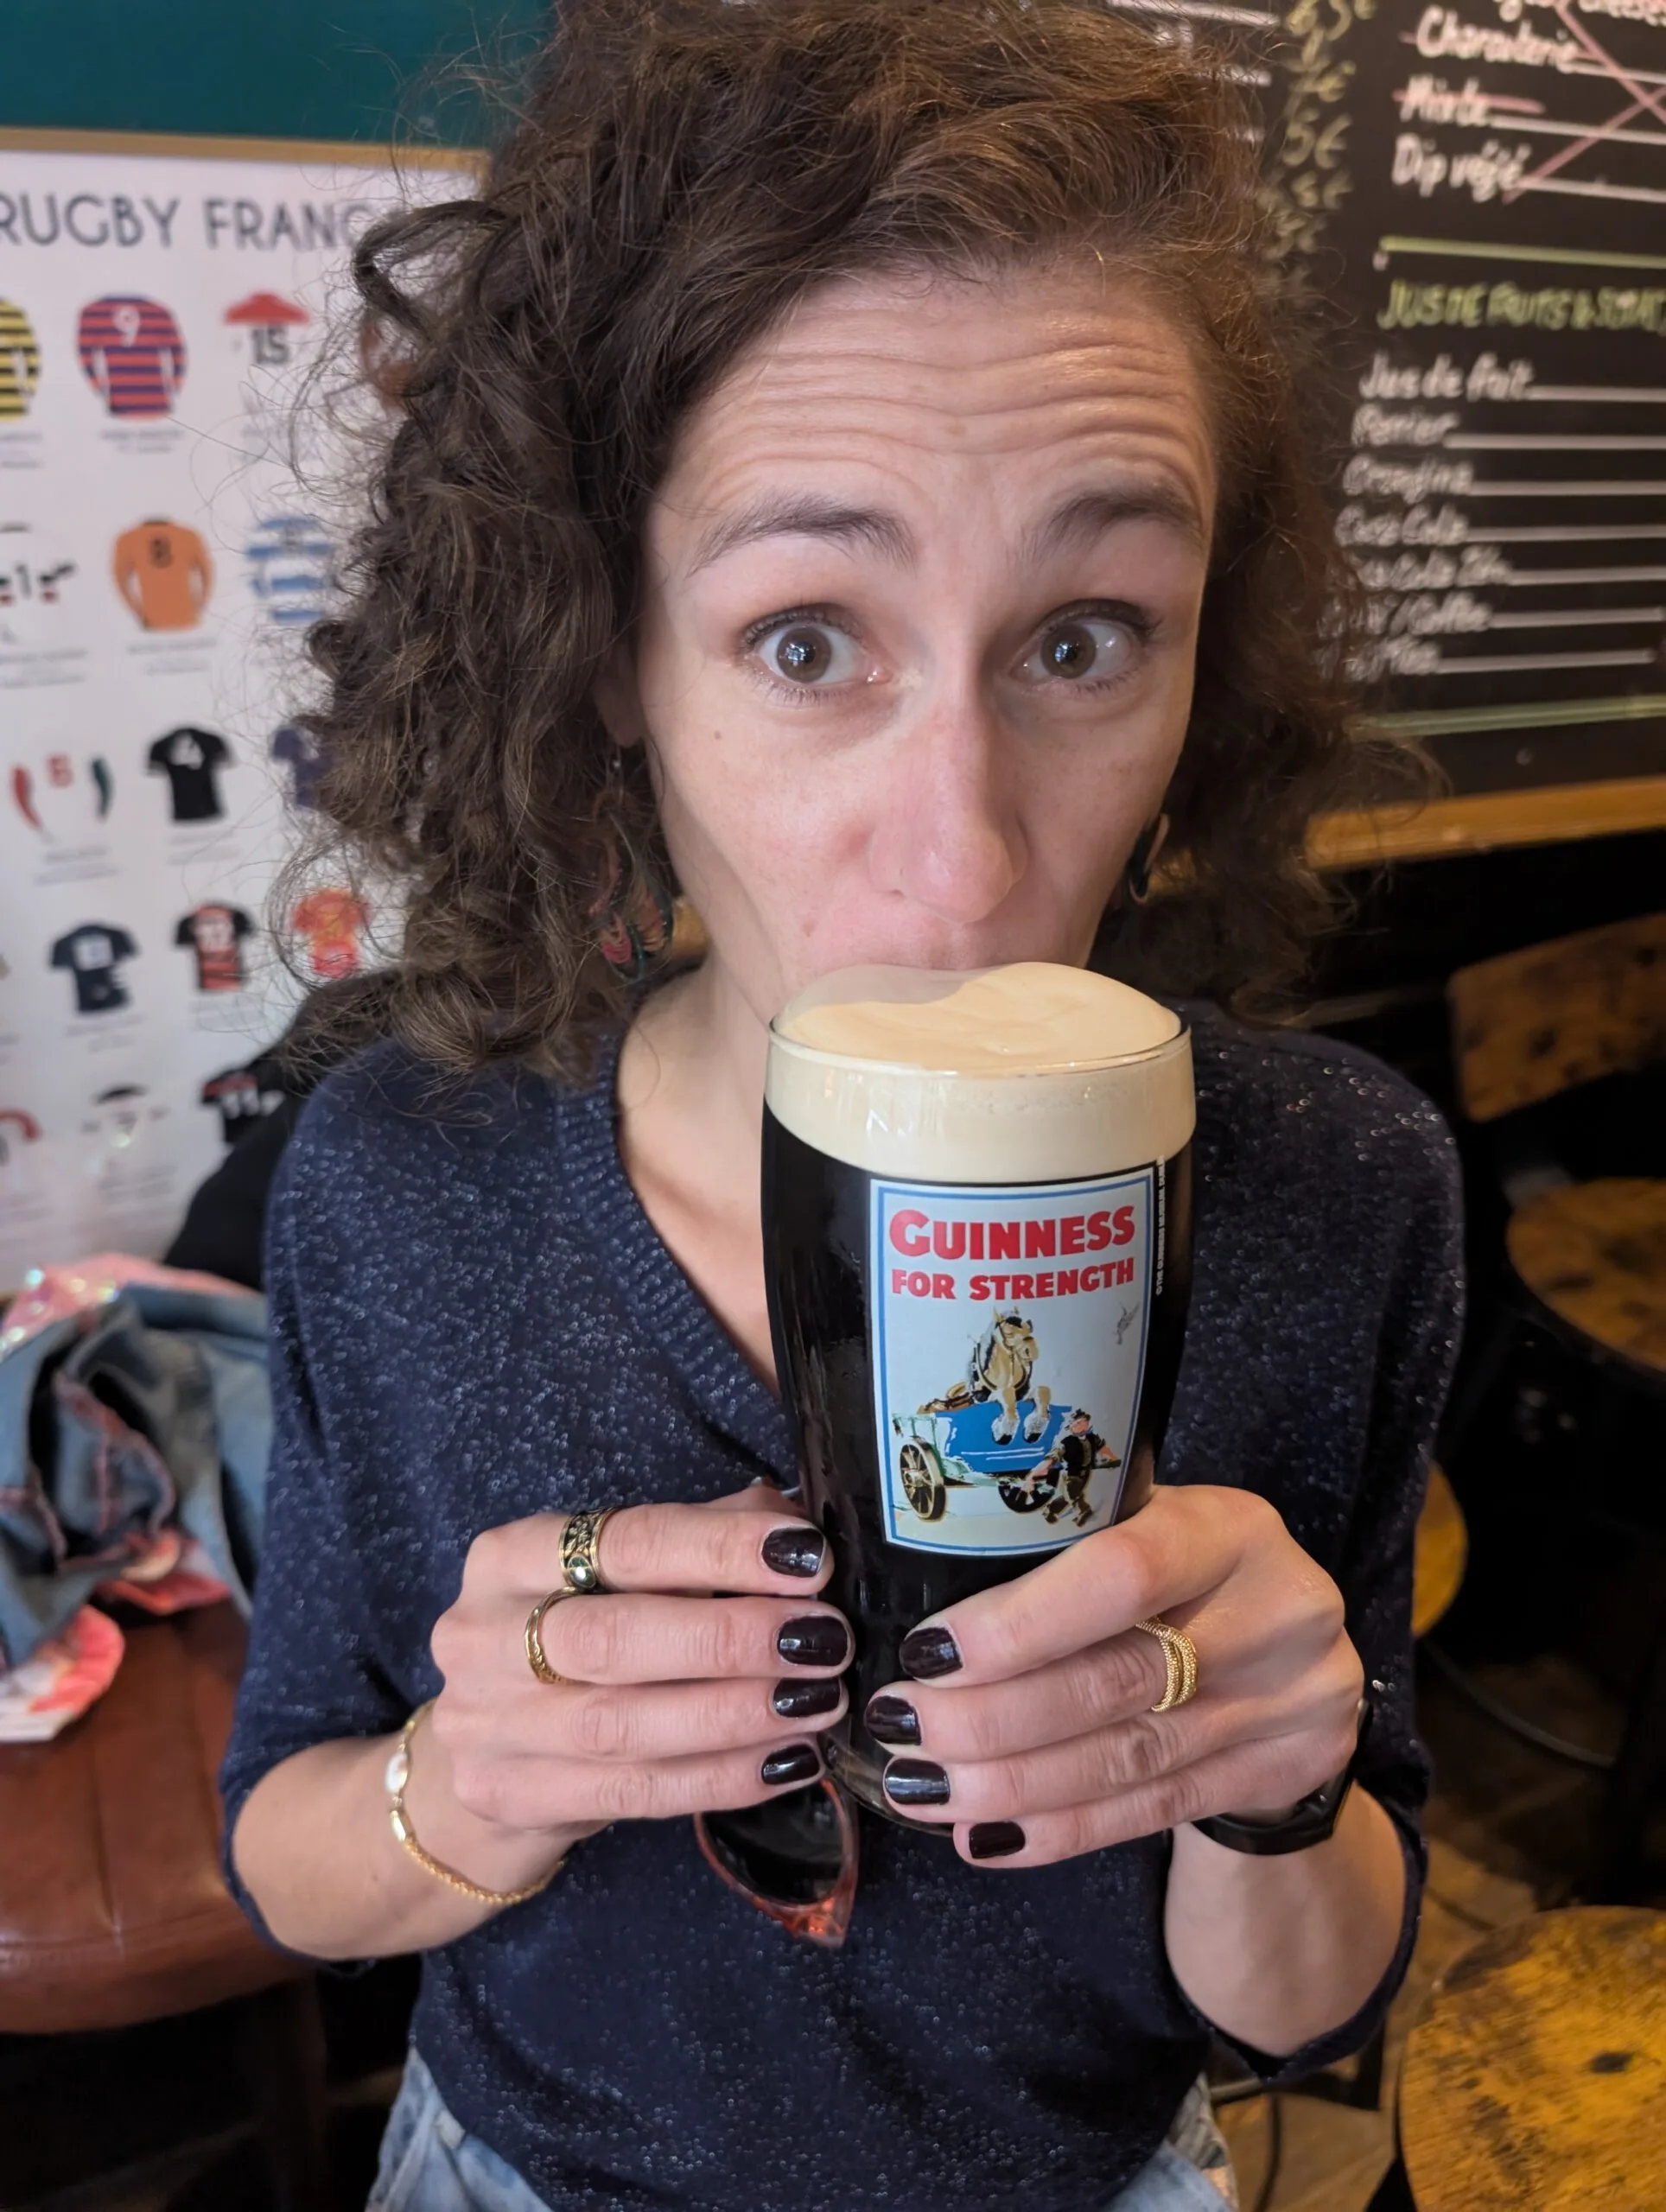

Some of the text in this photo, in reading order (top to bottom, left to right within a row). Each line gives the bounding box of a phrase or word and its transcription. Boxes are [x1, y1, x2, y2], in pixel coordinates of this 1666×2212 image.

[0, 192, 180, 251] RUGBY
[889, 1205, 1135, 1260] GUINNESS
[892, 1257, 1135, 1300] FOR STRENGTH
